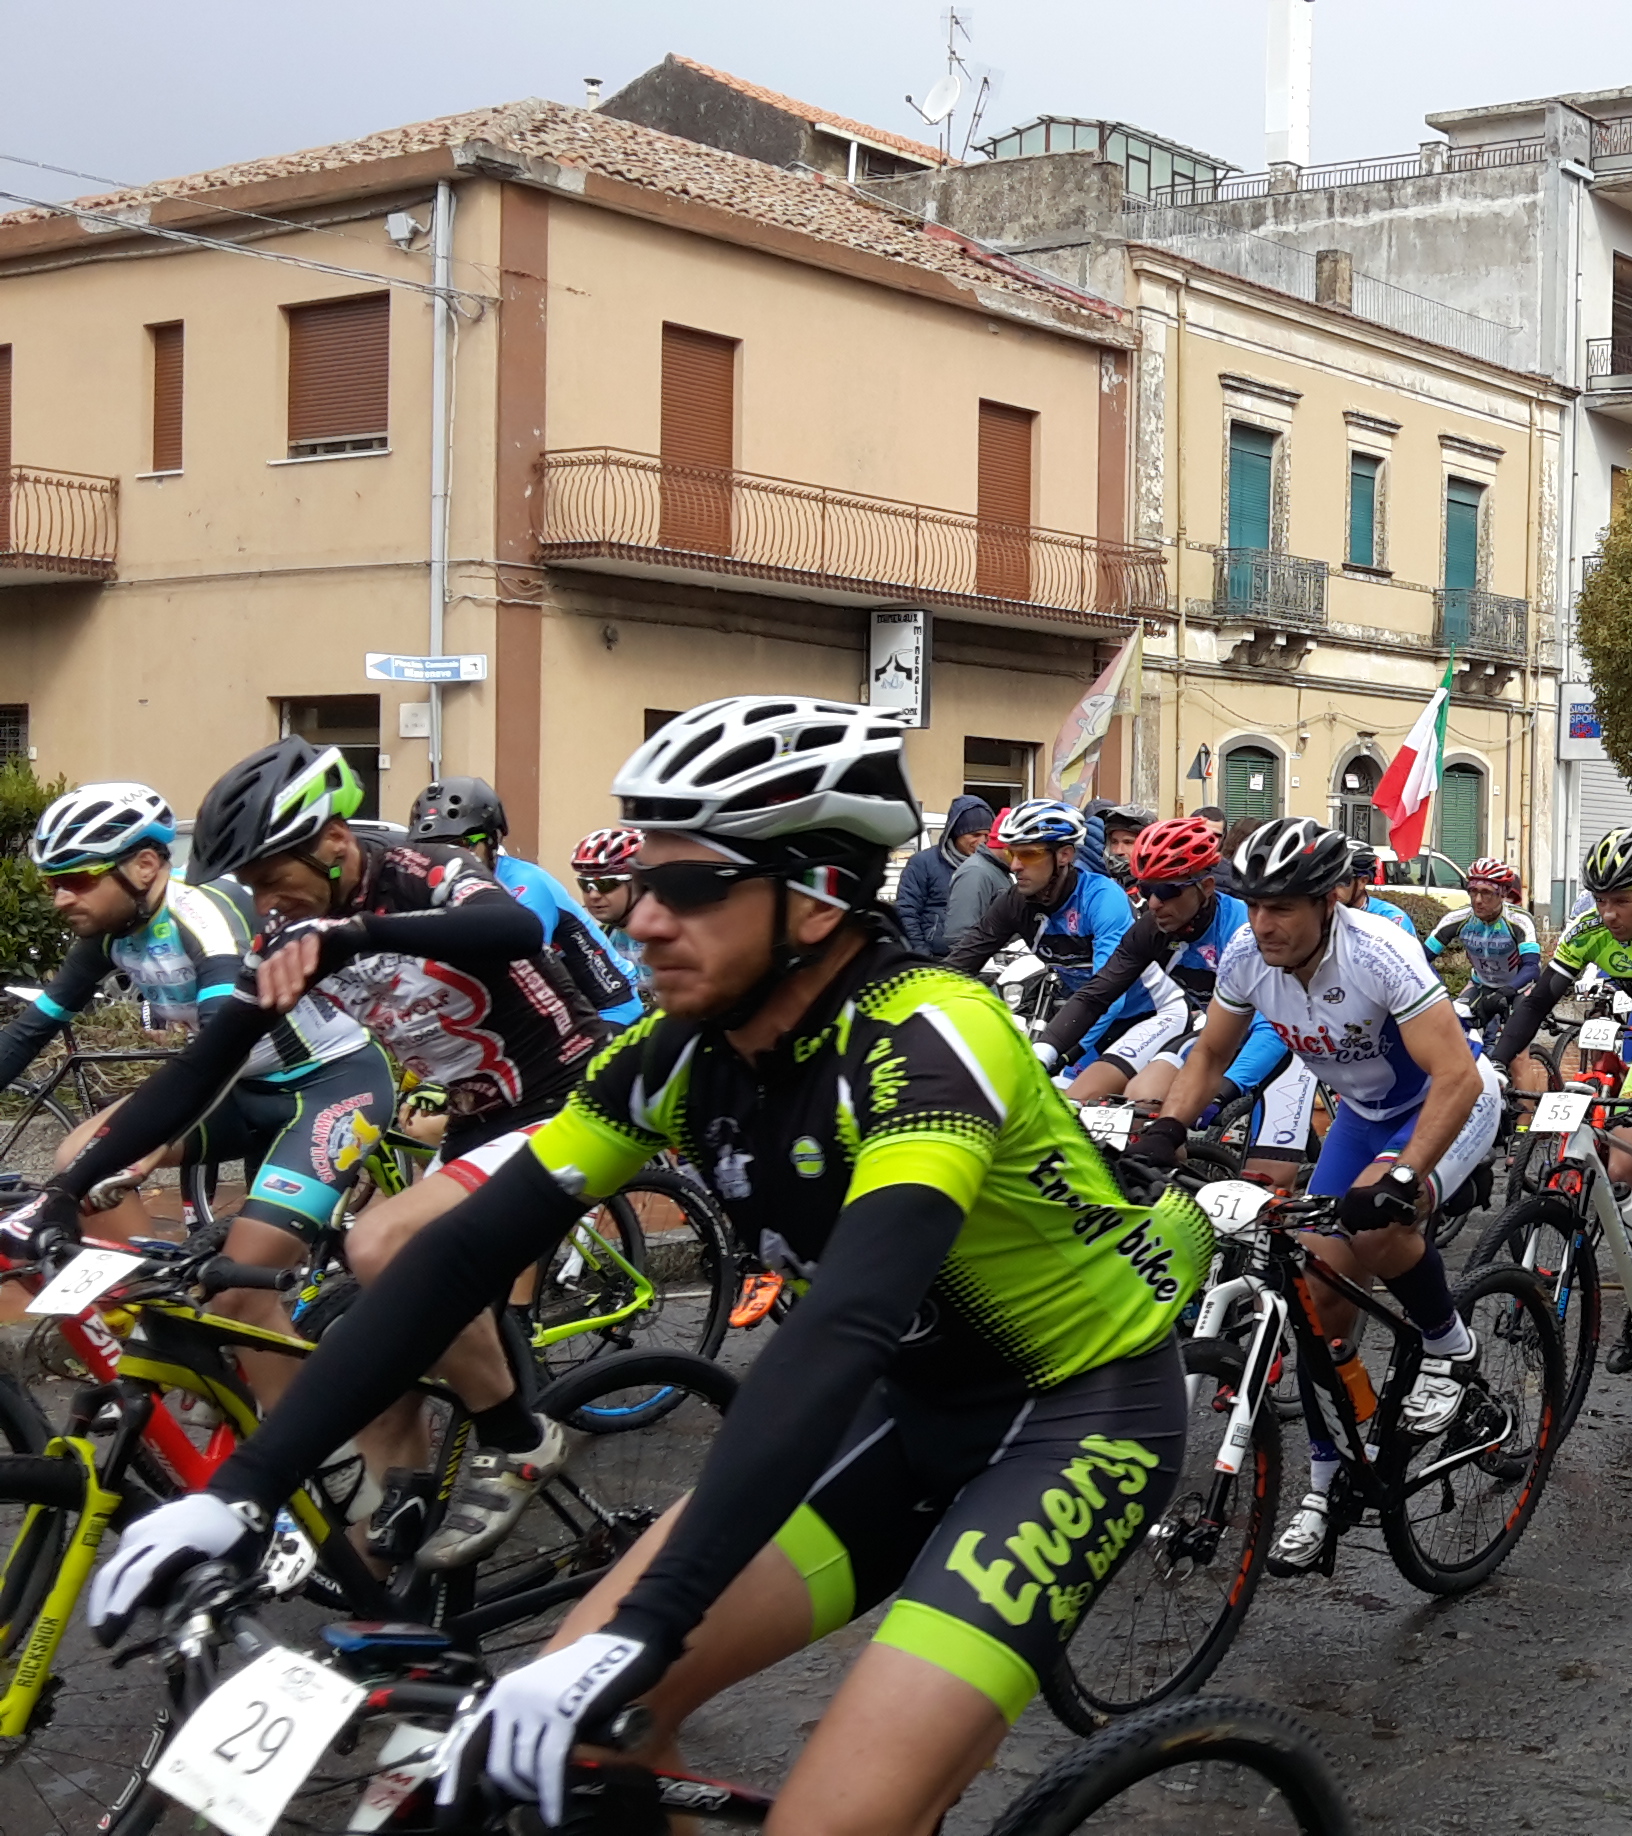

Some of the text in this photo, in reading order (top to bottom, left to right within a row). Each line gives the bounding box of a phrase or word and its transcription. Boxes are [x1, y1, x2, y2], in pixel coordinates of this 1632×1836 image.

[1269, 1020, 1338, 1054] Bici
[1336, 1034, 1395, 1064] Club
[1584, 1026, 1611, 1041] 225
[1547, 1104, 1572, 1121] 55
[310, 1091, 374, 1184] SICULAIMPIANTI
[1091, 1121, 1115, 1142] 52
[1209, 1195, 1241, 1220] 51
[1028, 1151, 1125, 1247] Energy
[1115, 1219, 1180, 1304] bike
[61, 1268, 104, 1295] 28
[1084, 1502, 1146, 1582] bike
[16, 1616, 60, 1689] ROCKSHOX
[557, 1642, 633, 1720] GIRO
[212, 1699, 297, 1776] 29
